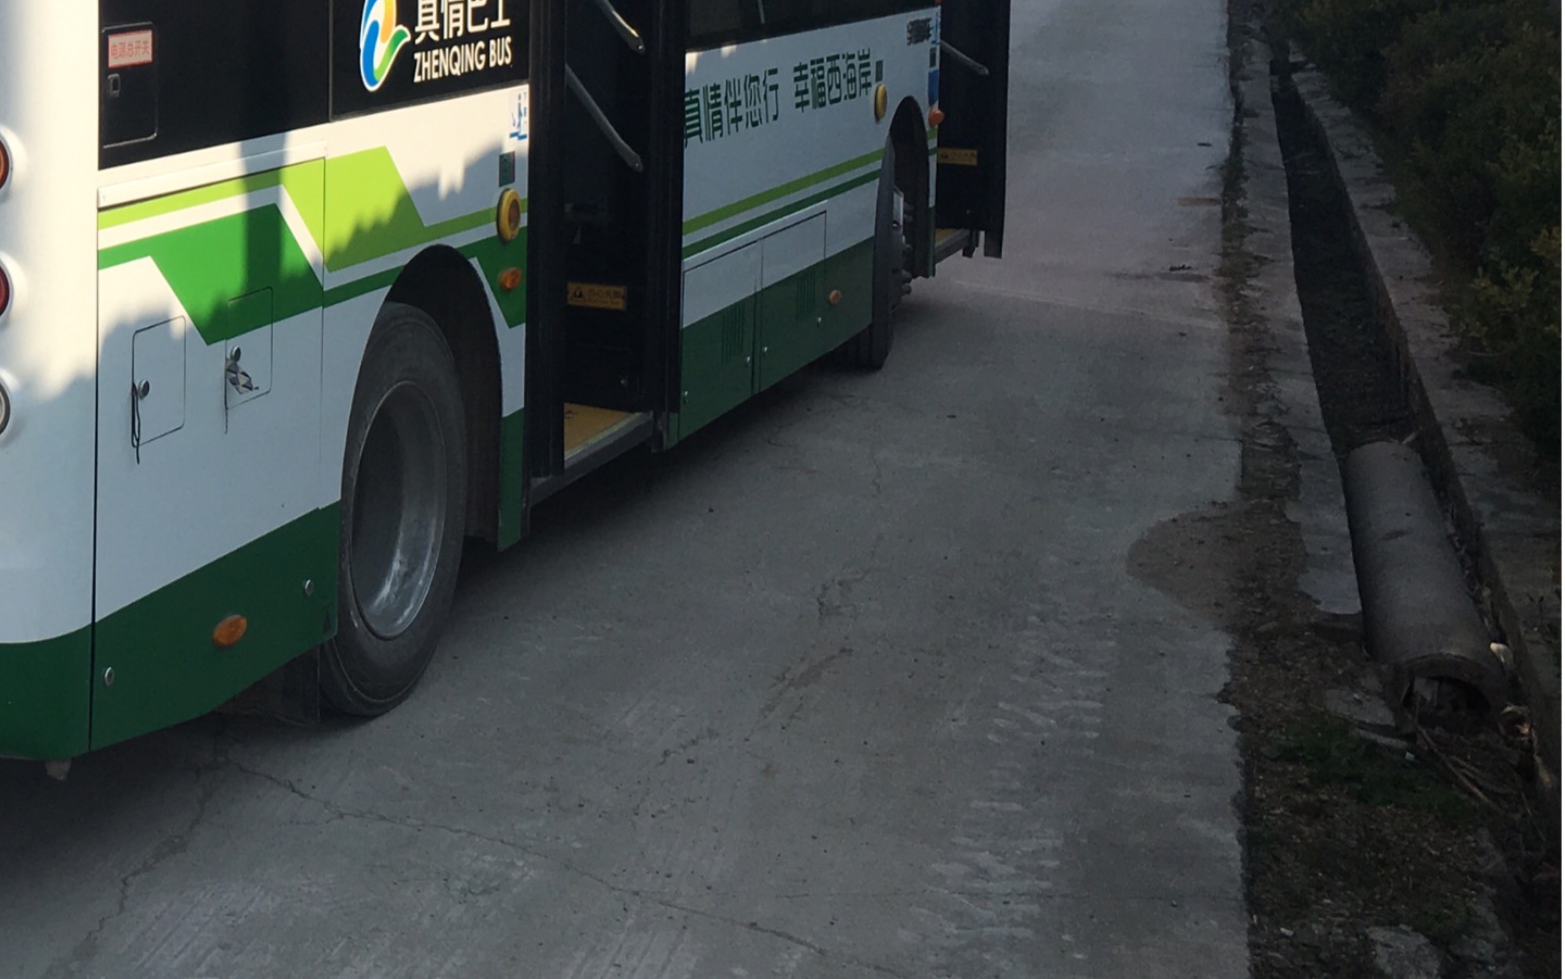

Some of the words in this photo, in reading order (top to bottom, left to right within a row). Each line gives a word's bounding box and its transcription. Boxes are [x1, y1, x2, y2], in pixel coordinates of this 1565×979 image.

[413, 40, 486, 83] ZHENQING
[489, 35, 513, 68] BUS
[684, 68, 779, 148] 真情伴您行
[793, 48, 872, 113] 幸福西海岸
